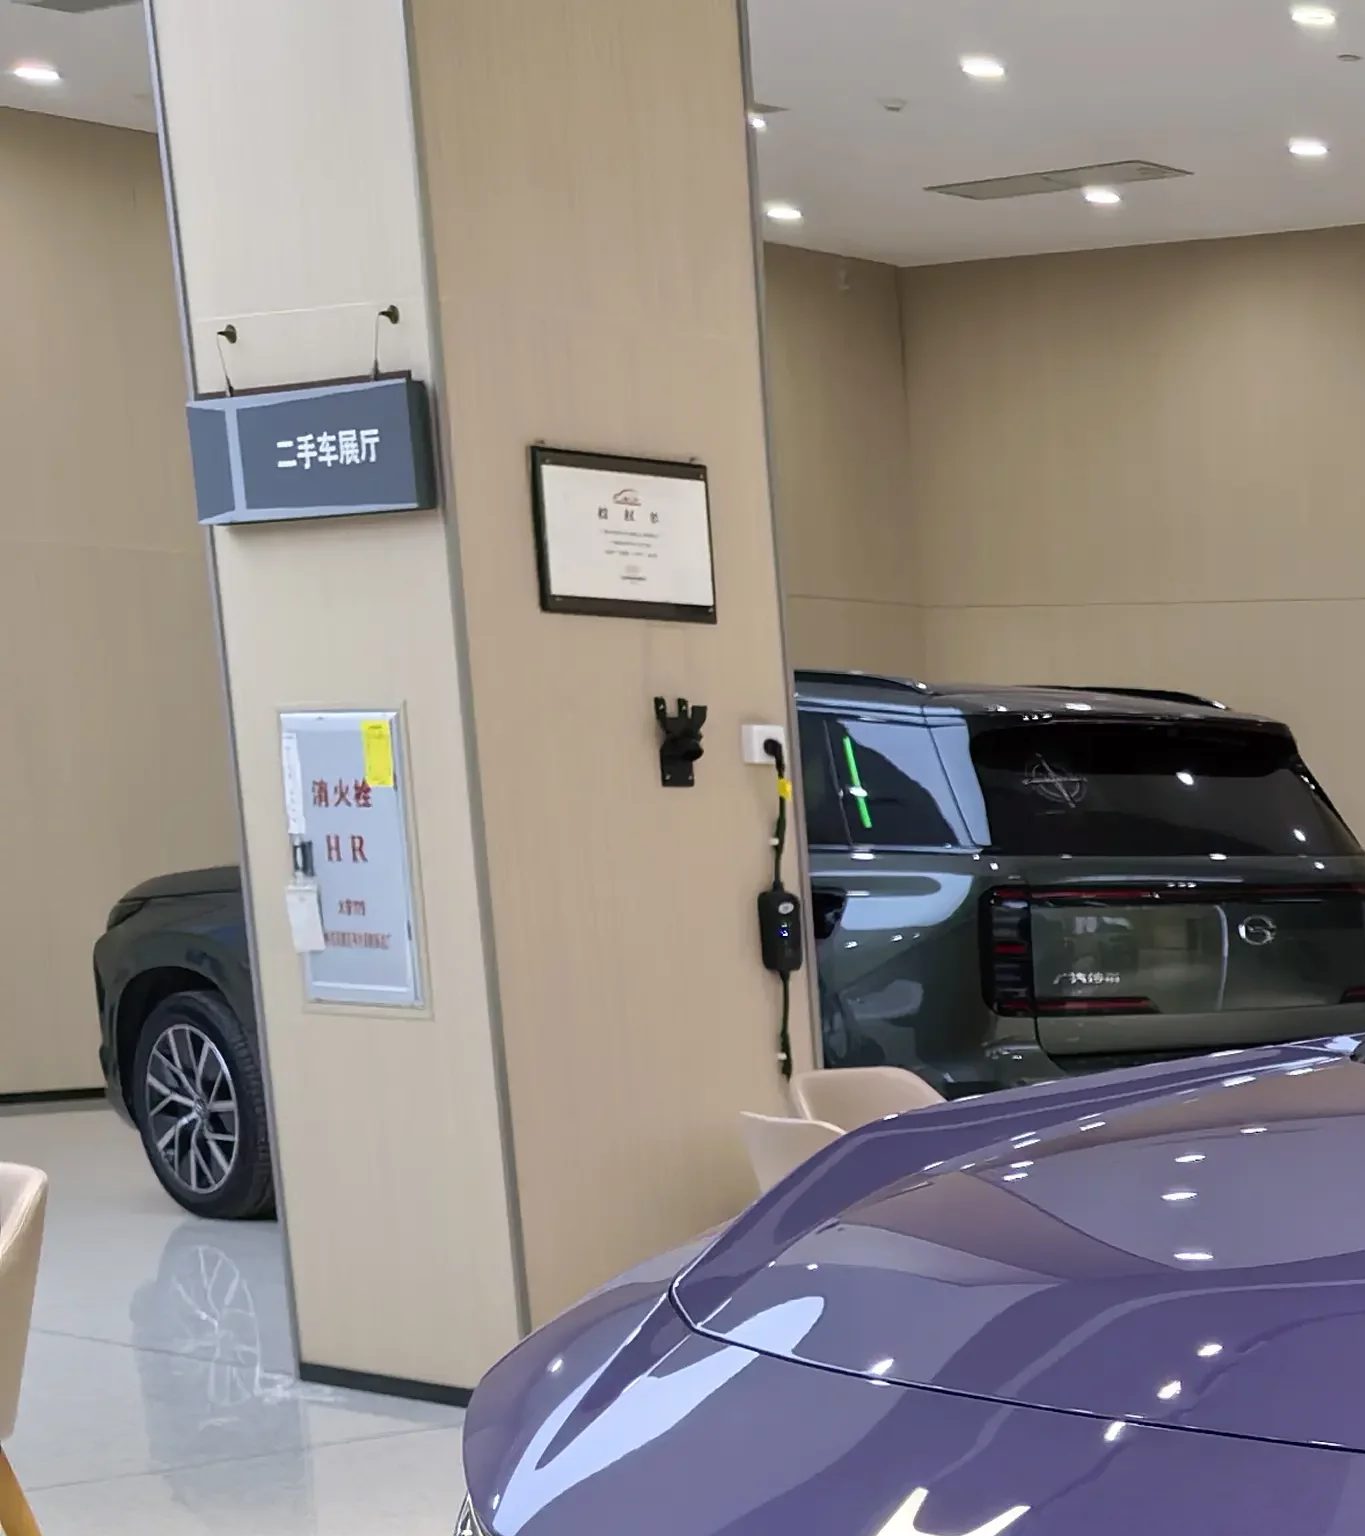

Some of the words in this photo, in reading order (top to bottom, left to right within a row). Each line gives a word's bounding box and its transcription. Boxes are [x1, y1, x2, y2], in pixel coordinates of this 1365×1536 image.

[276, 428, 380, 471] 二手车展厅
[311, 777, 373, 809] 消火栓
